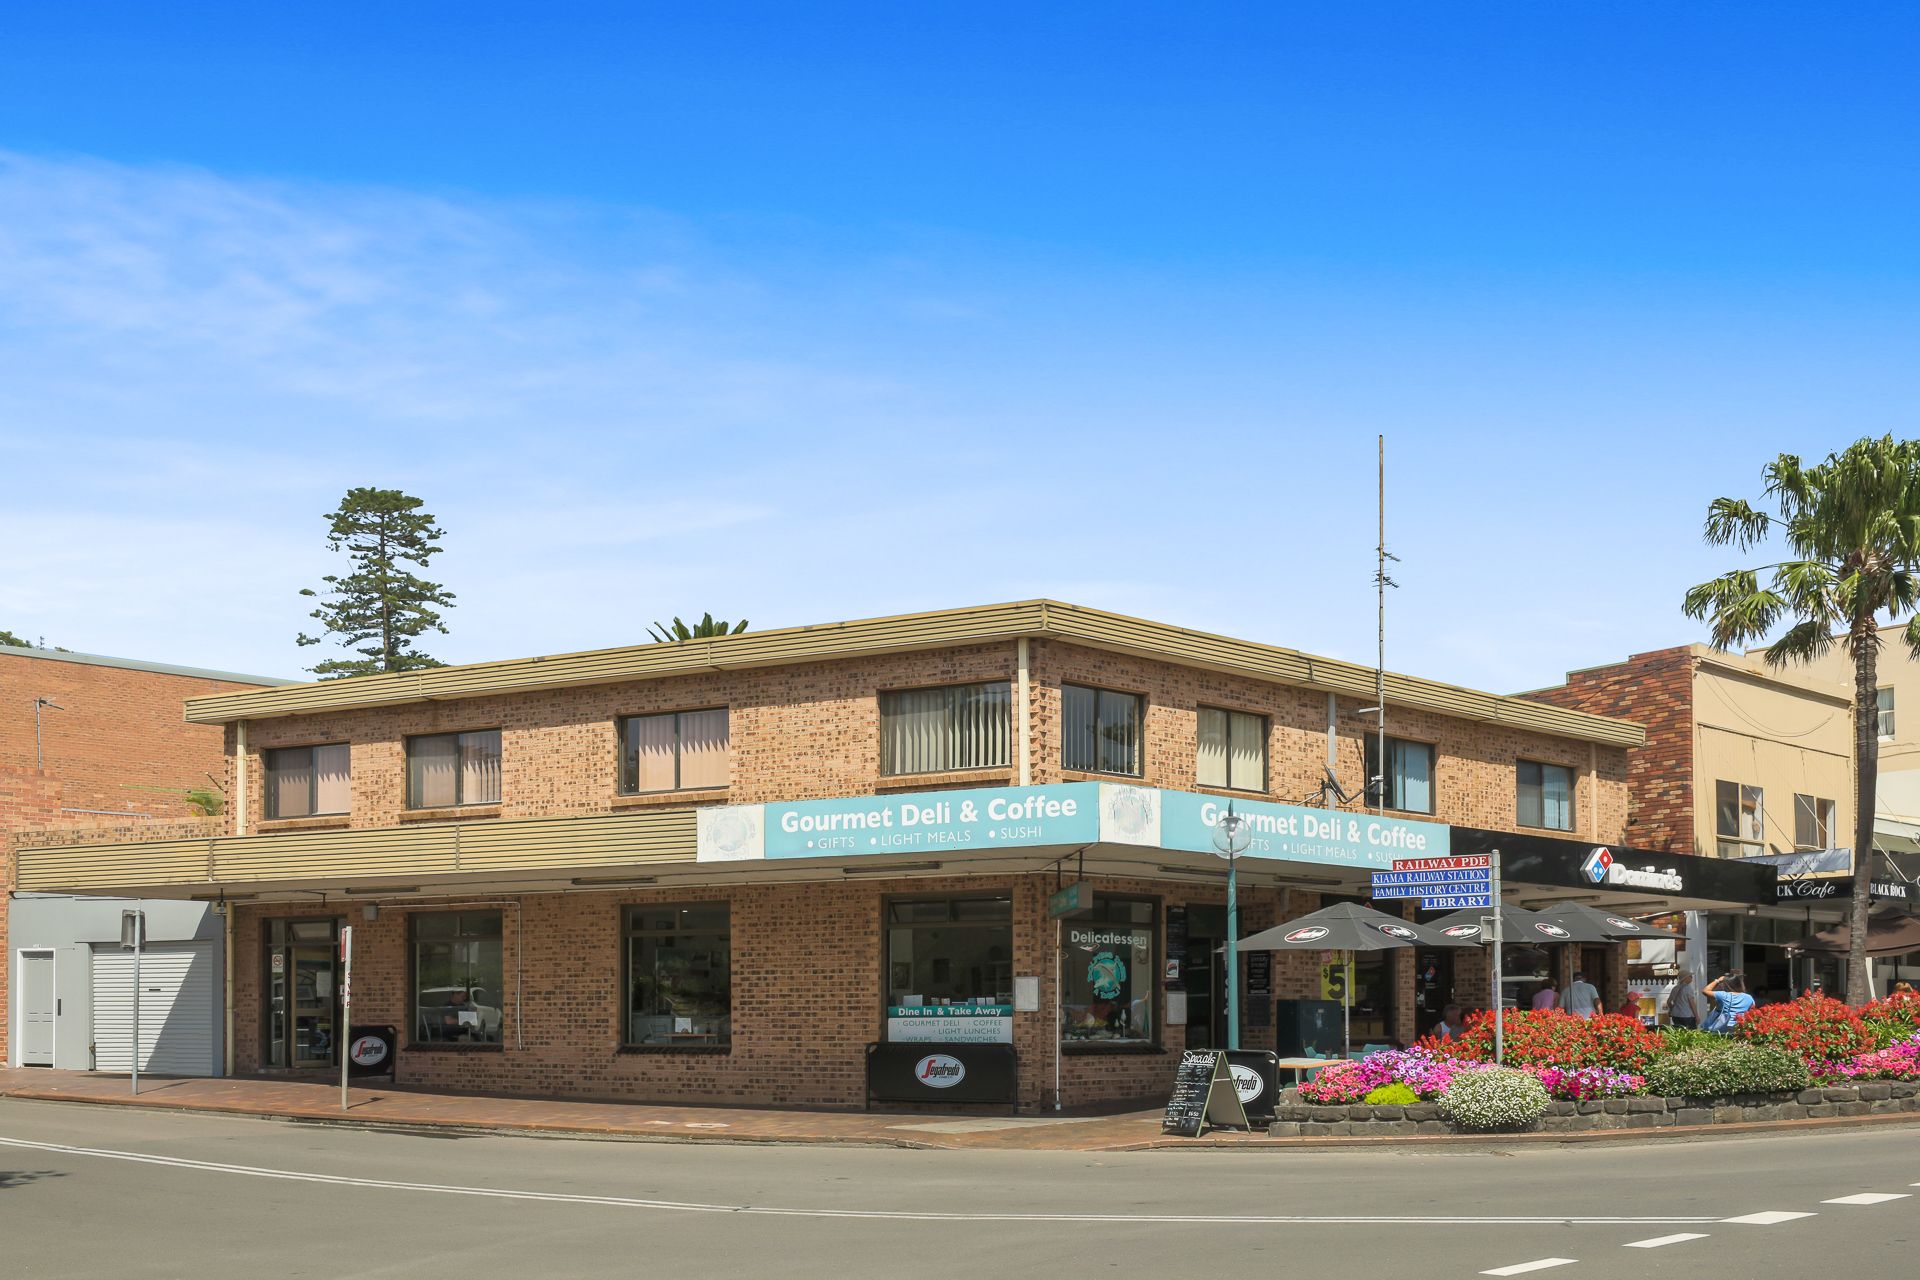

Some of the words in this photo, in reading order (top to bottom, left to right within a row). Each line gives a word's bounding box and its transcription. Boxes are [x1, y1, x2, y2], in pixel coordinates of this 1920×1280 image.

[781, 806, 893, 833] Gourmet
[901, 801, 950, 826] Deli
[959, 800, 978, 823] &
[988, 795, 1077, 821] Coffee
[818, 836, 855, 849] GIFTS
[881, 832, 922, 846] LIGHT
[927, 830, 971, 844] MEALS
[1001, 826, 1042, 840] SUSHI
[1303, 814, 1341, 841] Deli
[1347, 820, 1360, 843] &
[1367, 822, 1426, 850] Coffee
[1247, 838, 1270, 851] FTS
[1291, 843, 1323, 857] LIGHT
[1325, 846, 1358, 860] MEALS
[1395, 858, 1457, 871] RAILWAY
[1461, 856, 1487, 867] PDE
[1373, 873, 1404, 884] KIAMA
[1406, 872, 1446, 883] RAILWAY
[1447, 869, 1486, 881] STATION
[1375, 886, 1407, 897] FAMILY
[1409, 885, 1448, 895] HISTORY
[1448, 882, 1486, 894] CENTRE
[1793, 879, 1836, 899] Cafe
[1870, 882, 1889, 896] BLACK
[1890, 883, 1906, 898] ROCK
[1424, 896, 1486, 908] LIBRARY
[1071, 930, 1147, 945] Delicatessen
[898, 1008, 920, 1016] Dine
[923, 1008, 932, 1016] In
[937, 1008, 944, 1016] &
[948, 1007, 972, 1016] Take
[975, 1007, 1002, 1017] Away
[1182, 1050, 1216, 1067] Specials
